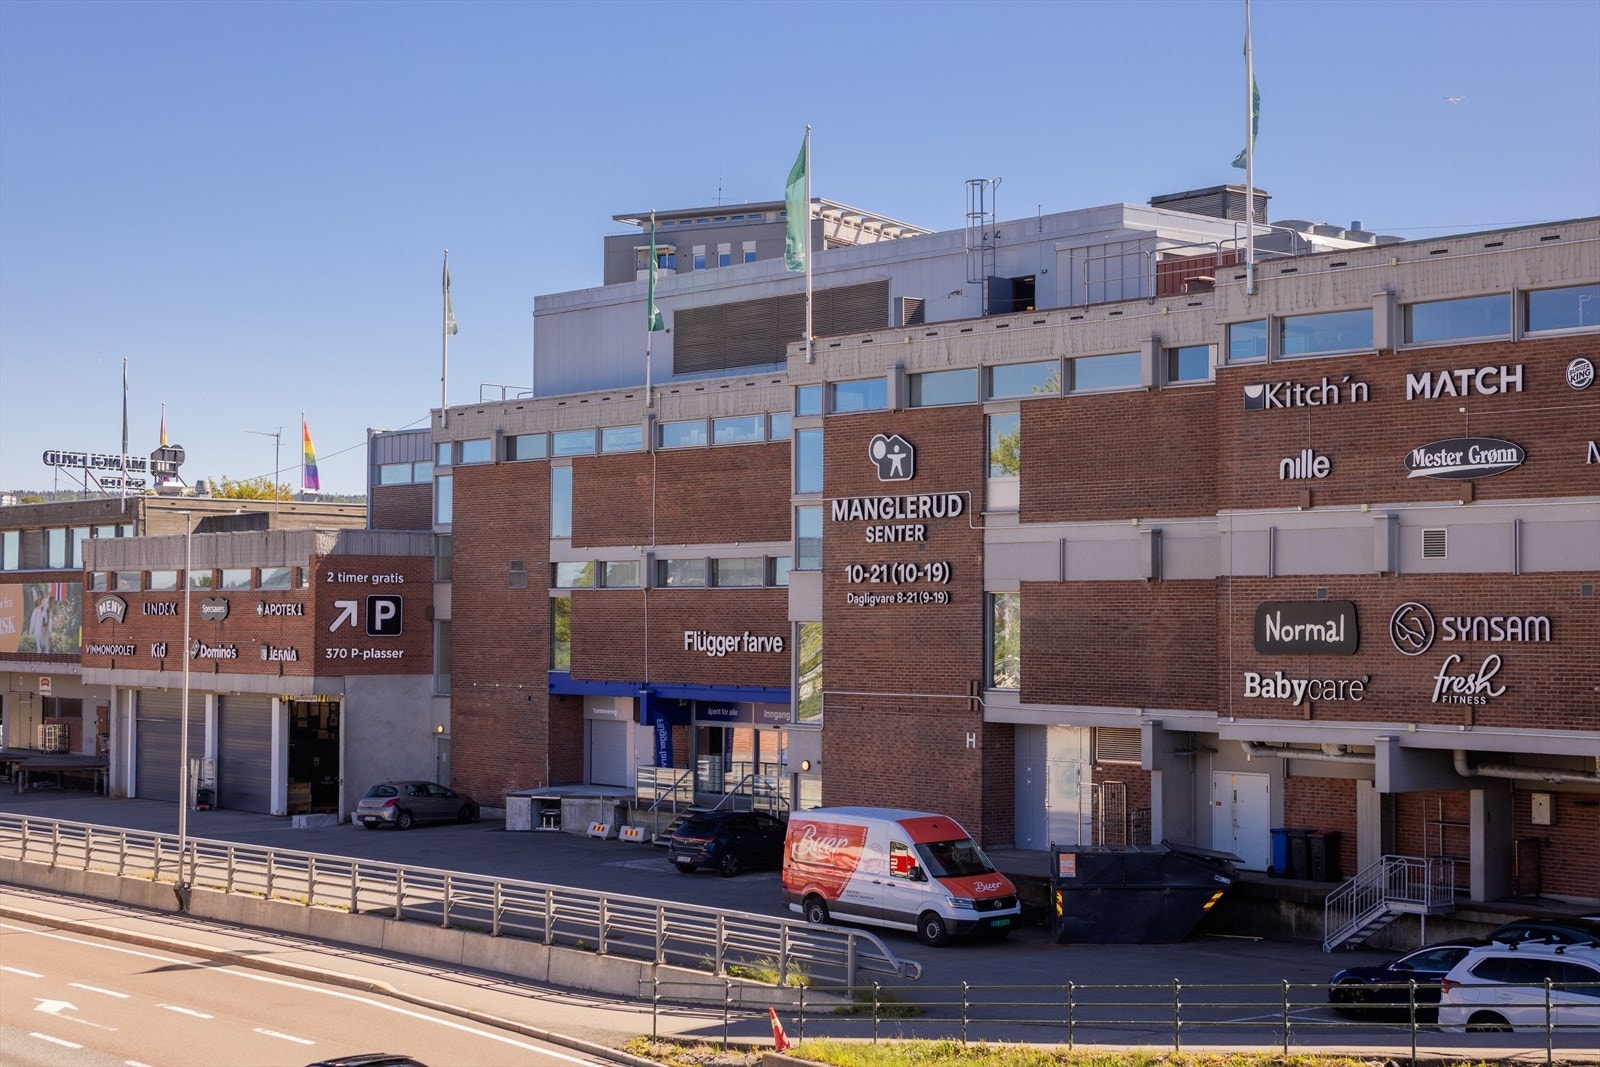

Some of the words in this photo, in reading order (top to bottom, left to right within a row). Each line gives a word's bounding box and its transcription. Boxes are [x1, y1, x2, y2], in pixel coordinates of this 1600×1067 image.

[1406, 364, 1522, 401] MATCH
[1571, 369, 1590, 382] KING
[1279, 448, 1330, 480] nille
[1412, 448, 1463, 467] Mester
[1468, 445, 1517, 464] Grønn
[831, 494, 962, 521] MANGLERUD
[865, 524, 925, 543] SENTER
[326, 572, 334, 582] 2
[337, 571, 368, 583] timer
[371, 572, 404, 585] gratis
[844, 564, 888, 584] 10-21
[892, 561, 950, 586] (10-19)
[847, 592, 895, 607] Dagligvare
[897, 592, 917, 604] 8-21
[919, 591, 949, 605] (9-19)
[98, 600, 123, 616] MENY
[143, 602, 177, 616] LINDEX
[202, 604, 226, 614] Specsavers
[375, 600, 396, 631] P
[1265, 610, 1345, 643] Normal
[1441, 616, 1551, 641] SYNSAM
[86, 644, 135, 656] VINMONOPOLET
[151, 642, 166, 658] Kid
[200, 644, 237, 659] Domino's
[684, 630, 741, 657] Flügger
[743, 631, 783, 653] farve
[325, 648, 348, 659] 370
[351, 648, 404, 661] P-plasser
[1431, 654, 1506, 703] fresh
[1442, 695, 1487, 705] FITNESS
[763, 709, 791, 721] Inngang
[966, 732, 976, 749] H
[792, 823, 849, 860] Buer
[973, 881, 1003, 893] Buer
